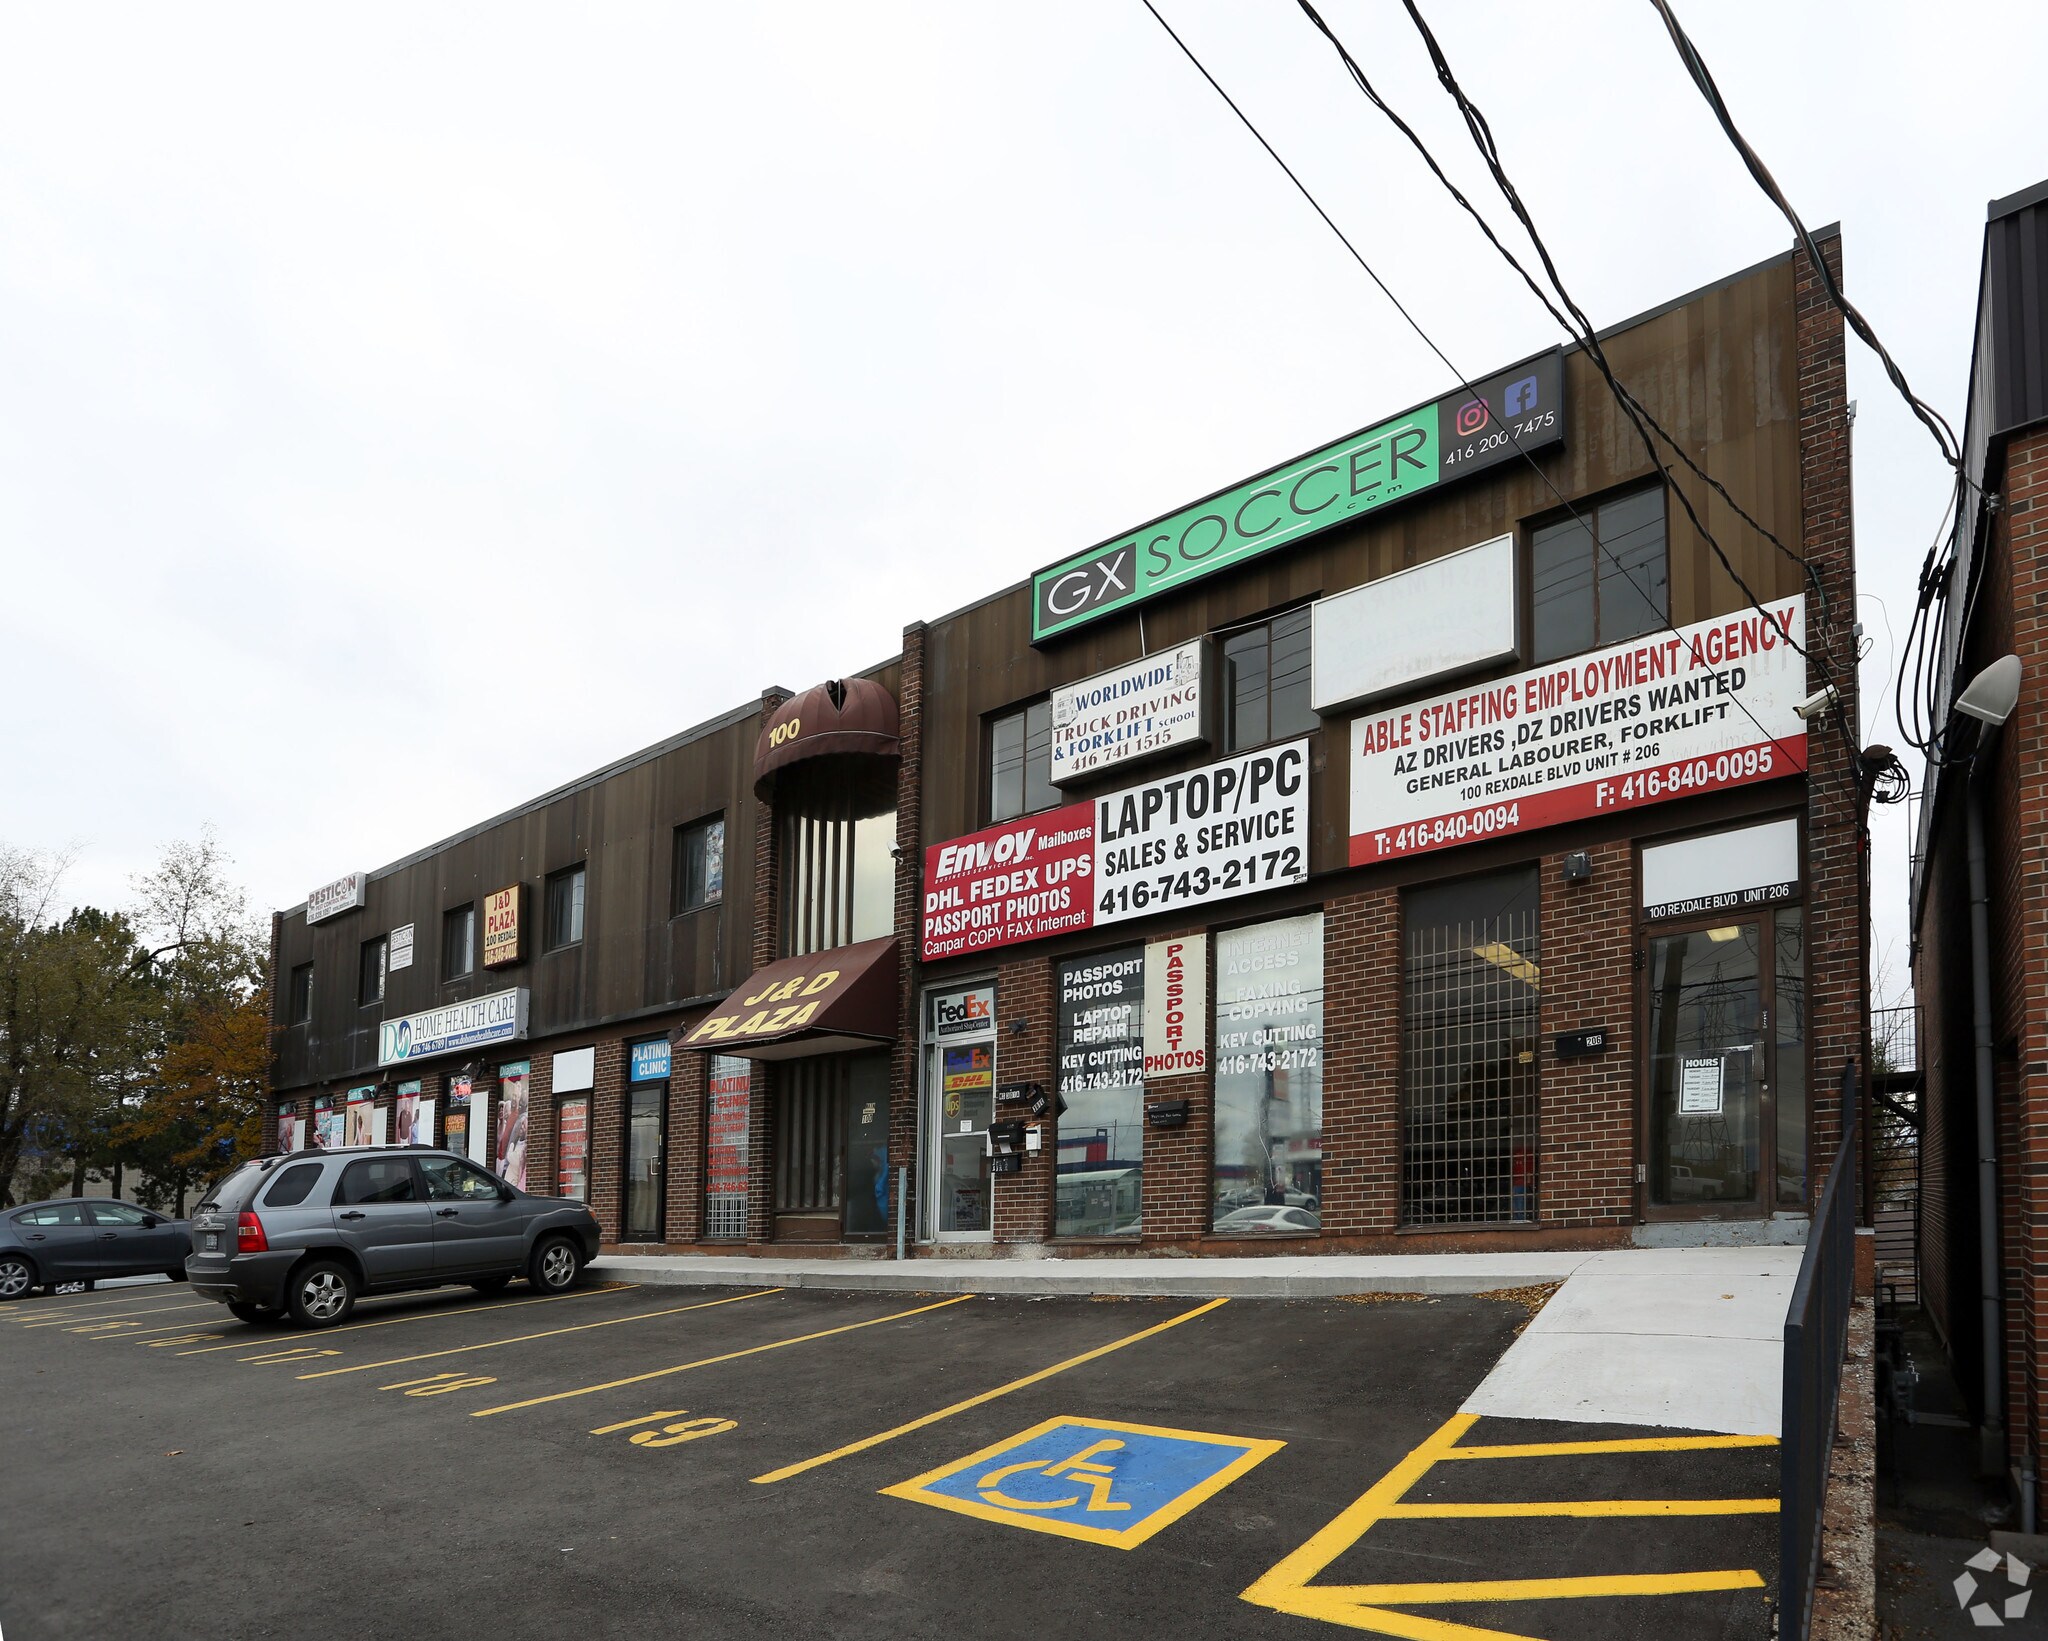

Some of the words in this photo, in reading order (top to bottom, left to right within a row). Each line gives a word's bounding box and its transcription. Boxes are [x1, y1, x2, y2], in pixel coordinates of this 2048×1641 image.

[1445, 444, 1474, 465] 416
[1479, 430, 1509, 454] 200
[1514, 411, 1554, 439] 7475
[1338, 484, 1402, 514] .com
[1047, 550, 1127, 616] GX
[1145, 428, 1427, 577] SOCCER
[1076, 663, 1173, 711] WORLDWIDE
[1362, 713, 1412, 756] ABLE
[1418, 685, 1517, 742] STAFFING
[1525, 639, 1681, 714] EMPLOYMENT
[1689, 607, 1795, 671] AGENCY
[1053, 714, 1111, 744] TRUCK
[1116, 686, 1196, 725] DRIVING
[1393, 751, 1418, 776] AZ
[1423, 729, 1505, 769] DRIVERS
[1550, 693, 1641, 737] DRIVERS
[1648, 667, 1746, 712] WANTED
[769, 718, 800, 748] 100
[1054, 746, 1065, 761] &
[1069, 717, 1154, 757] FORKLIFT
[1158, 711, 1196, 728] SCHOOL
[1071, 753, 1098, 771] 416
[1103, 742, 1129, 761] 741
[1136, 728, 1171, 752] 1515
[1406, 761, 1492, 794] GENERAL
[1498, 733, 1613, 773] LABOURER,
[1621, 702, 1730, 743] FORKLIFT
[1460, 785, 1481, 801] 100
[1485, 770, 1543, 796] REXDALE
[1547, 762, 1581, 781] BLVD
[1585, 751, 1619, 772] UNIT
[1622, 749, 1631, 763] #
[1635, 743, 1660, 761] 206
[1596, 781, 1615, 808] F:
[1621, 746, 1773, 801] 416-840-0095
[1100, 749, 1301, 844] LAPTOP/PC
[1038, 826, 1092, 851] Mailboxes
[1105, 838, 1166, 877] SALES
[1174, 833, 1189, 860] &
[1197, 806, 1295, 854] SERVICE
[1375, 833, 1391, 855] T:
[1395, 802, 1519, 850] 416-840-0094
[926, 886, 964, 914] DHL
[971, 867, 1039, 903] FEDEX
[1045, 854, 1092, 885] UPS
[934, 869, 971, 884] BUSINESS
[973, 861, 1012, 875] SERVICES
[1099, 846, 1301, 915] 416-743-2172
[493, 890, 510, 911] J&D
[925, 902, 1001, 938] PASSPORT
[1006, 886, 1071, 921] PHOTOS
[1649, 905, 1665, 918] 100
[1667, 898, 1712, 915] REXDALE
[1713, 893, 1738, 908] BLVD
[1744, 888, 1767, 903] UNIT
[1769, 884, 1789, 899] 206
[488, 909, 516, 934] PLAZA
[924, 936, 965, 955] Canpar
[968, 926, 1004, 947] COPY
[1007, 920, 1034, 938] FAX
[1037, 909, 1085, 933] Internet
[486, 934, 496, 946] 100
[498, 928, 516, 943] REXDALE
[1228, 930, 1313, 957] INTERNET
[1063, 958, 1143, 986] PASSPORT
[1227, 951, 1299, 975] ACCESS
[743, 970, 840, 1007] J&D
[1063, 979, 1123, 1003] PHOTOS
[1166, 943, 1184, 1051] PASSPORT
[1237, 978, 1301, 1001] FAXING
[415, 1013, 443, 1041] HOME
[445, 1000, 486, 1034] HEALTH
[488, 995, 516, 1024] CARE
[686, 1001, 821, 1043] PLAZA
[938, 994, 989, 1023] FedEx
[1073, 1004, 1132, 1026] LAPTOP
[1229, 998, 1308, 1021] COPYING
[940, 1024, 964, 1034] Authorized
[1073, 1023, 1127, 1043] REPAIR
[1220, 1031, 1249, 1049] KEY
[1252, 1023, 1317, 1046] CUTTING
[1586, 1034, 1602, 1047] 206
[412, 1044, 421, 1054] 416
[421, 1042, 431, 1053] 746
[432, 1039, 444, 1051] 6789
[1062, 1053, 1086, 1069] KEY
[1088, 1046, 1142, 1067] CUTTING
[1145, 1049, 1204, 1072] PHOTOS
[500, 1064, 522, 1077] Diapers
[639, 1060, 667, 1076] CLINIC
[947, 1048, 990, 1075] FedEx
[1219, 1047, 1317, 1075] 416-743-2172
[1685, 1058, 1719, 1067] HOURS
[951, 1074, 984, 1089] DHL
[1061, 1067, 1143, 1093] 416-743-2172
[717, 1093, 748, 1109] CLINIC
[947, 1100, 959, 1115] ups
[236, 1347, 344, 1365] 17
[377, 1371, 498, 1397] 18
[588, 1409, 739, 1448] 19
